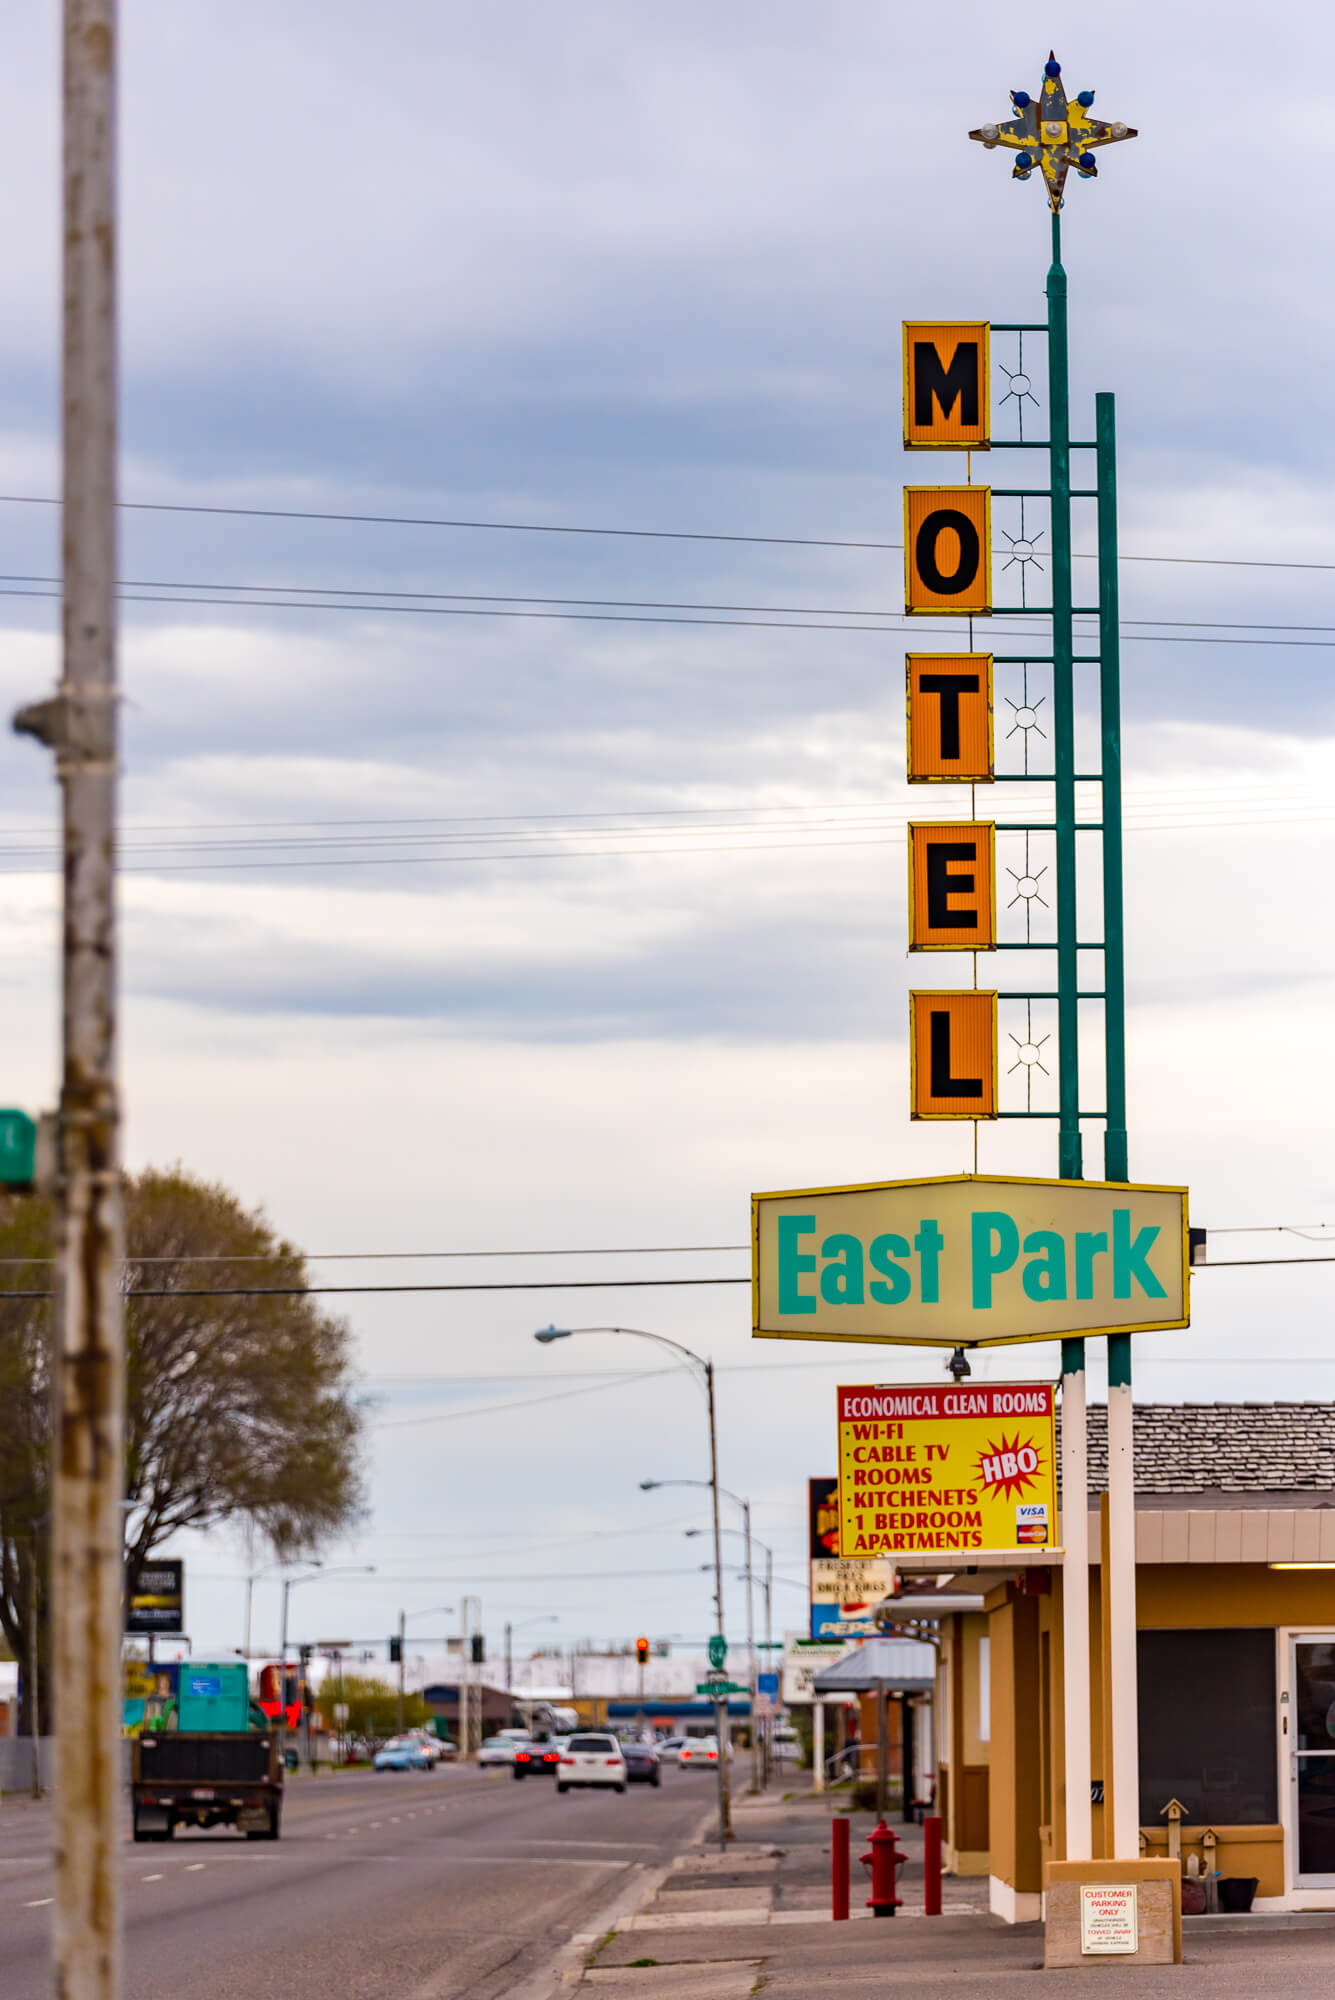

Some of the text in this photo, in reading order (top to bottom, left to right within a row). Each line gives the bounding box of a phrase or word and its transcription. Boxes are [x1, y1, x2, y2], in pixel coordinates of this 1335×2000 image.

[914, 342, 983, 1098] MOTEL
[778, 1208, 1168, 1315] East Park
[843, 1392, 1047, 1417] ECONOMICAL CLEAN ROOMS
[852, 1423, 904, 1441] WI-FI
[853, 1444, 950, 1463] CABLE TV
[981, 1447, 1038, 1483] HBO
[854, 1467, 932, 1486] ROOMS
[854, 1488, 978, 1508] KITCHENETS
[855, 1511, 983, 1530] 1 BEDROOM
[1020, 1507, 1045, 1516] VISA
[854, 1530, 983, 1550] APARTMENTS
[1085, 1890, 1133, 1899] CUSTOMER
[1091, 1899, 1127, 1907] PARKING
[1098, 1908, 1119, 1916] ONLY
